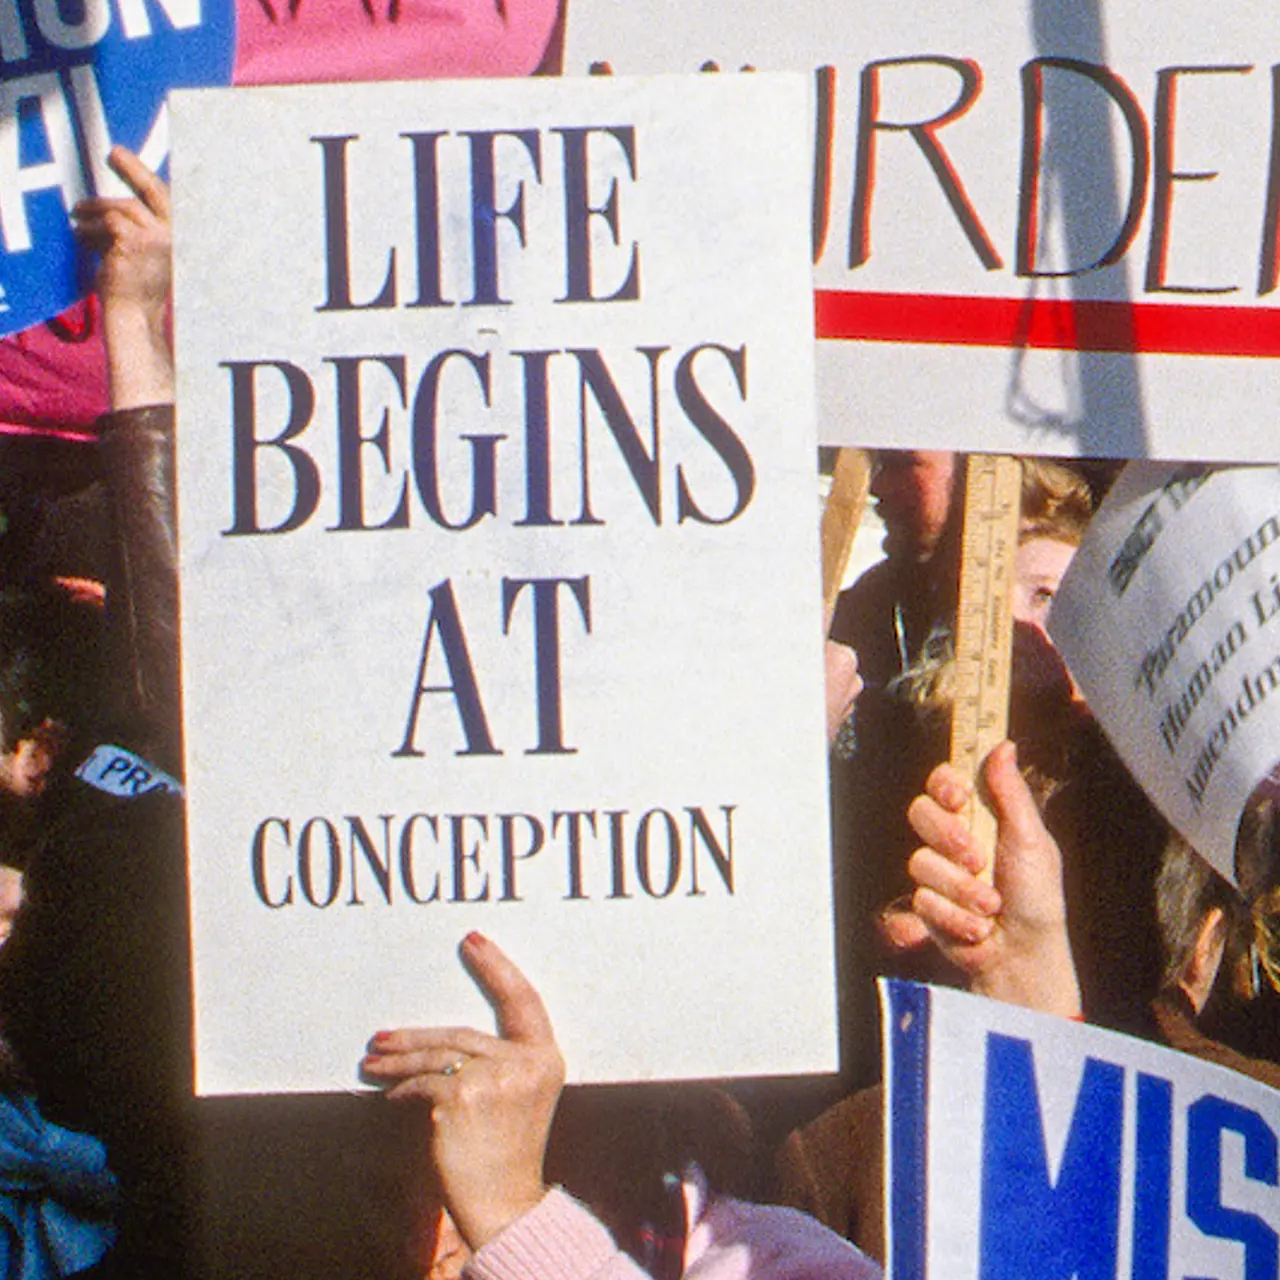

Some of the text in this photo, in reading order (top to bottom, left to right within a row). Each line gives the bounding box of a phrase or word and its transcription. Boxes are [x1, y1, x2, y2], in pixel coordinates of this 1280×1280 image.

[310, 124, 643, 314] LIFE
[218, 342, 758, 538] BEGINS
[390, 574, 593, 759] AT
[1157, 617, 1248, 756] Human
[250, 804, 738, 910] CONCEPTION
